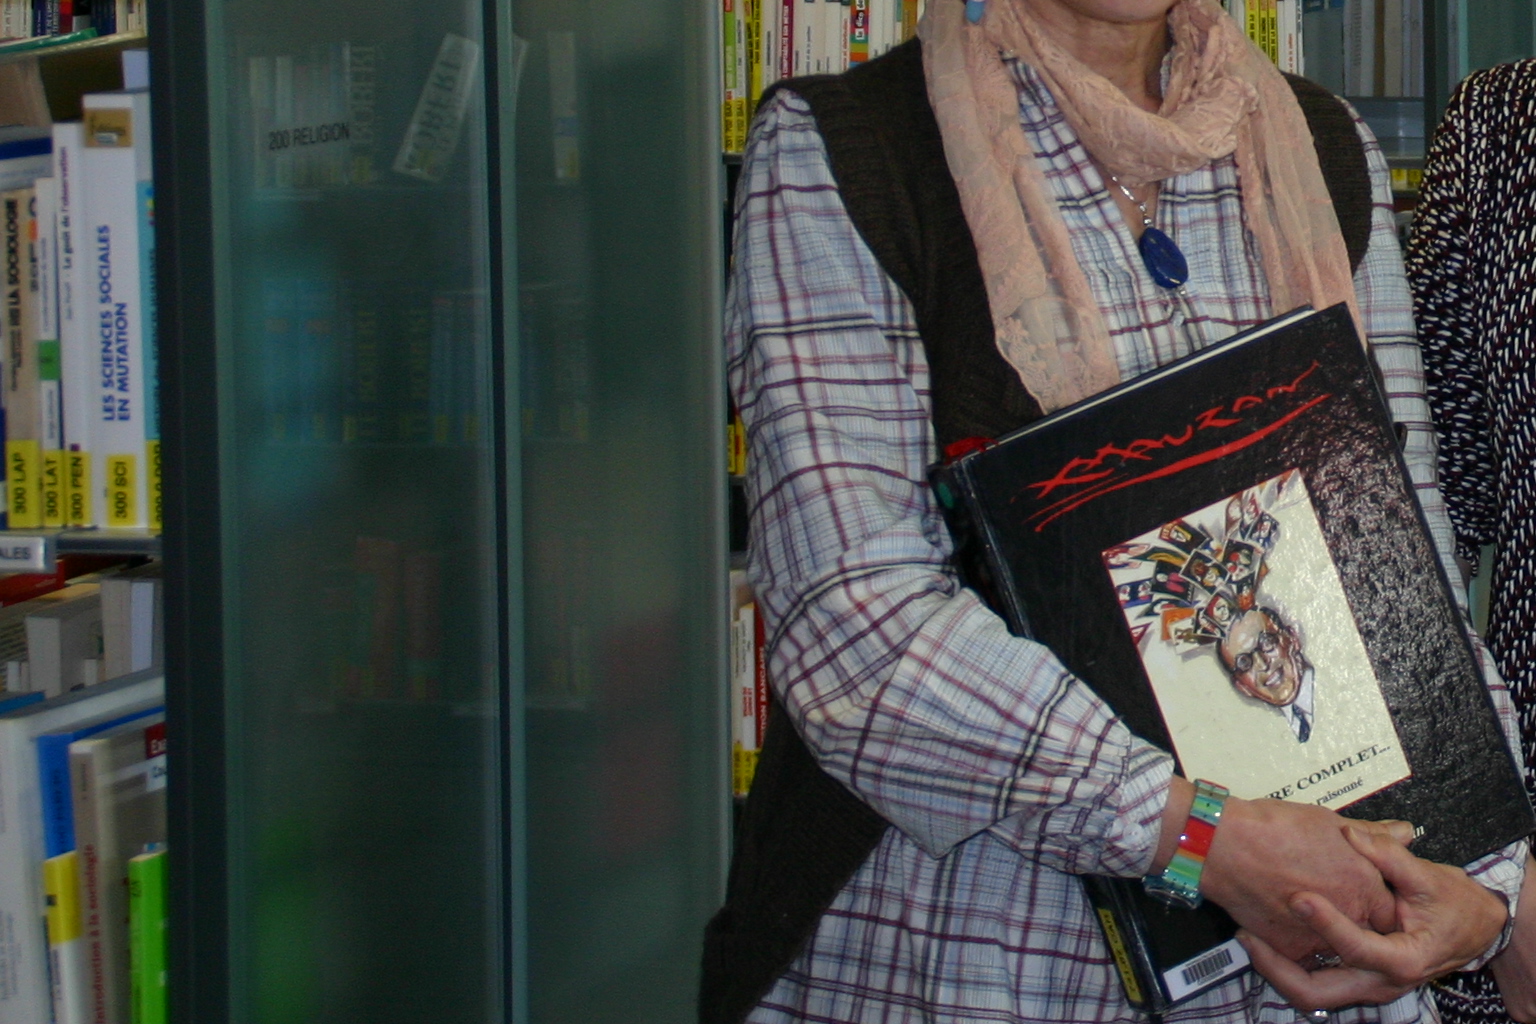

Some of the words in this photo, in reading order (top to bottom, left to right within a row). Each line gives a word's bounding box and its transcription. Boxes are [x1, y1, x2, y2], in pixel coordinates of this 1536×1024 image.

[856, 12, 864, 27] dico
[268, 130, 290, 150] 200
[293, 123, 350, 146] RELIGION
[97, 225, 111, 304] SOCIALES
[100, 310, 114, 388] SCIENCES
[114, 303, 130, 393] MUTATION
[102, 395, 115, 421] LES
[117, 399, 130, 421] EN
[12, 452, 25, 482] LAP
[45, 458, 57, 486] LAT
[70, 456, 82, 488] PEN
[114, 461, 126, 487] SCI
[13, 487, 26, 514] 300
[46, 491, 58, 517] 300
[71, 493, 83, 520] 300
[114, 492, 127, 518] 300
[1315, 777, 1365, 807] raisonné
